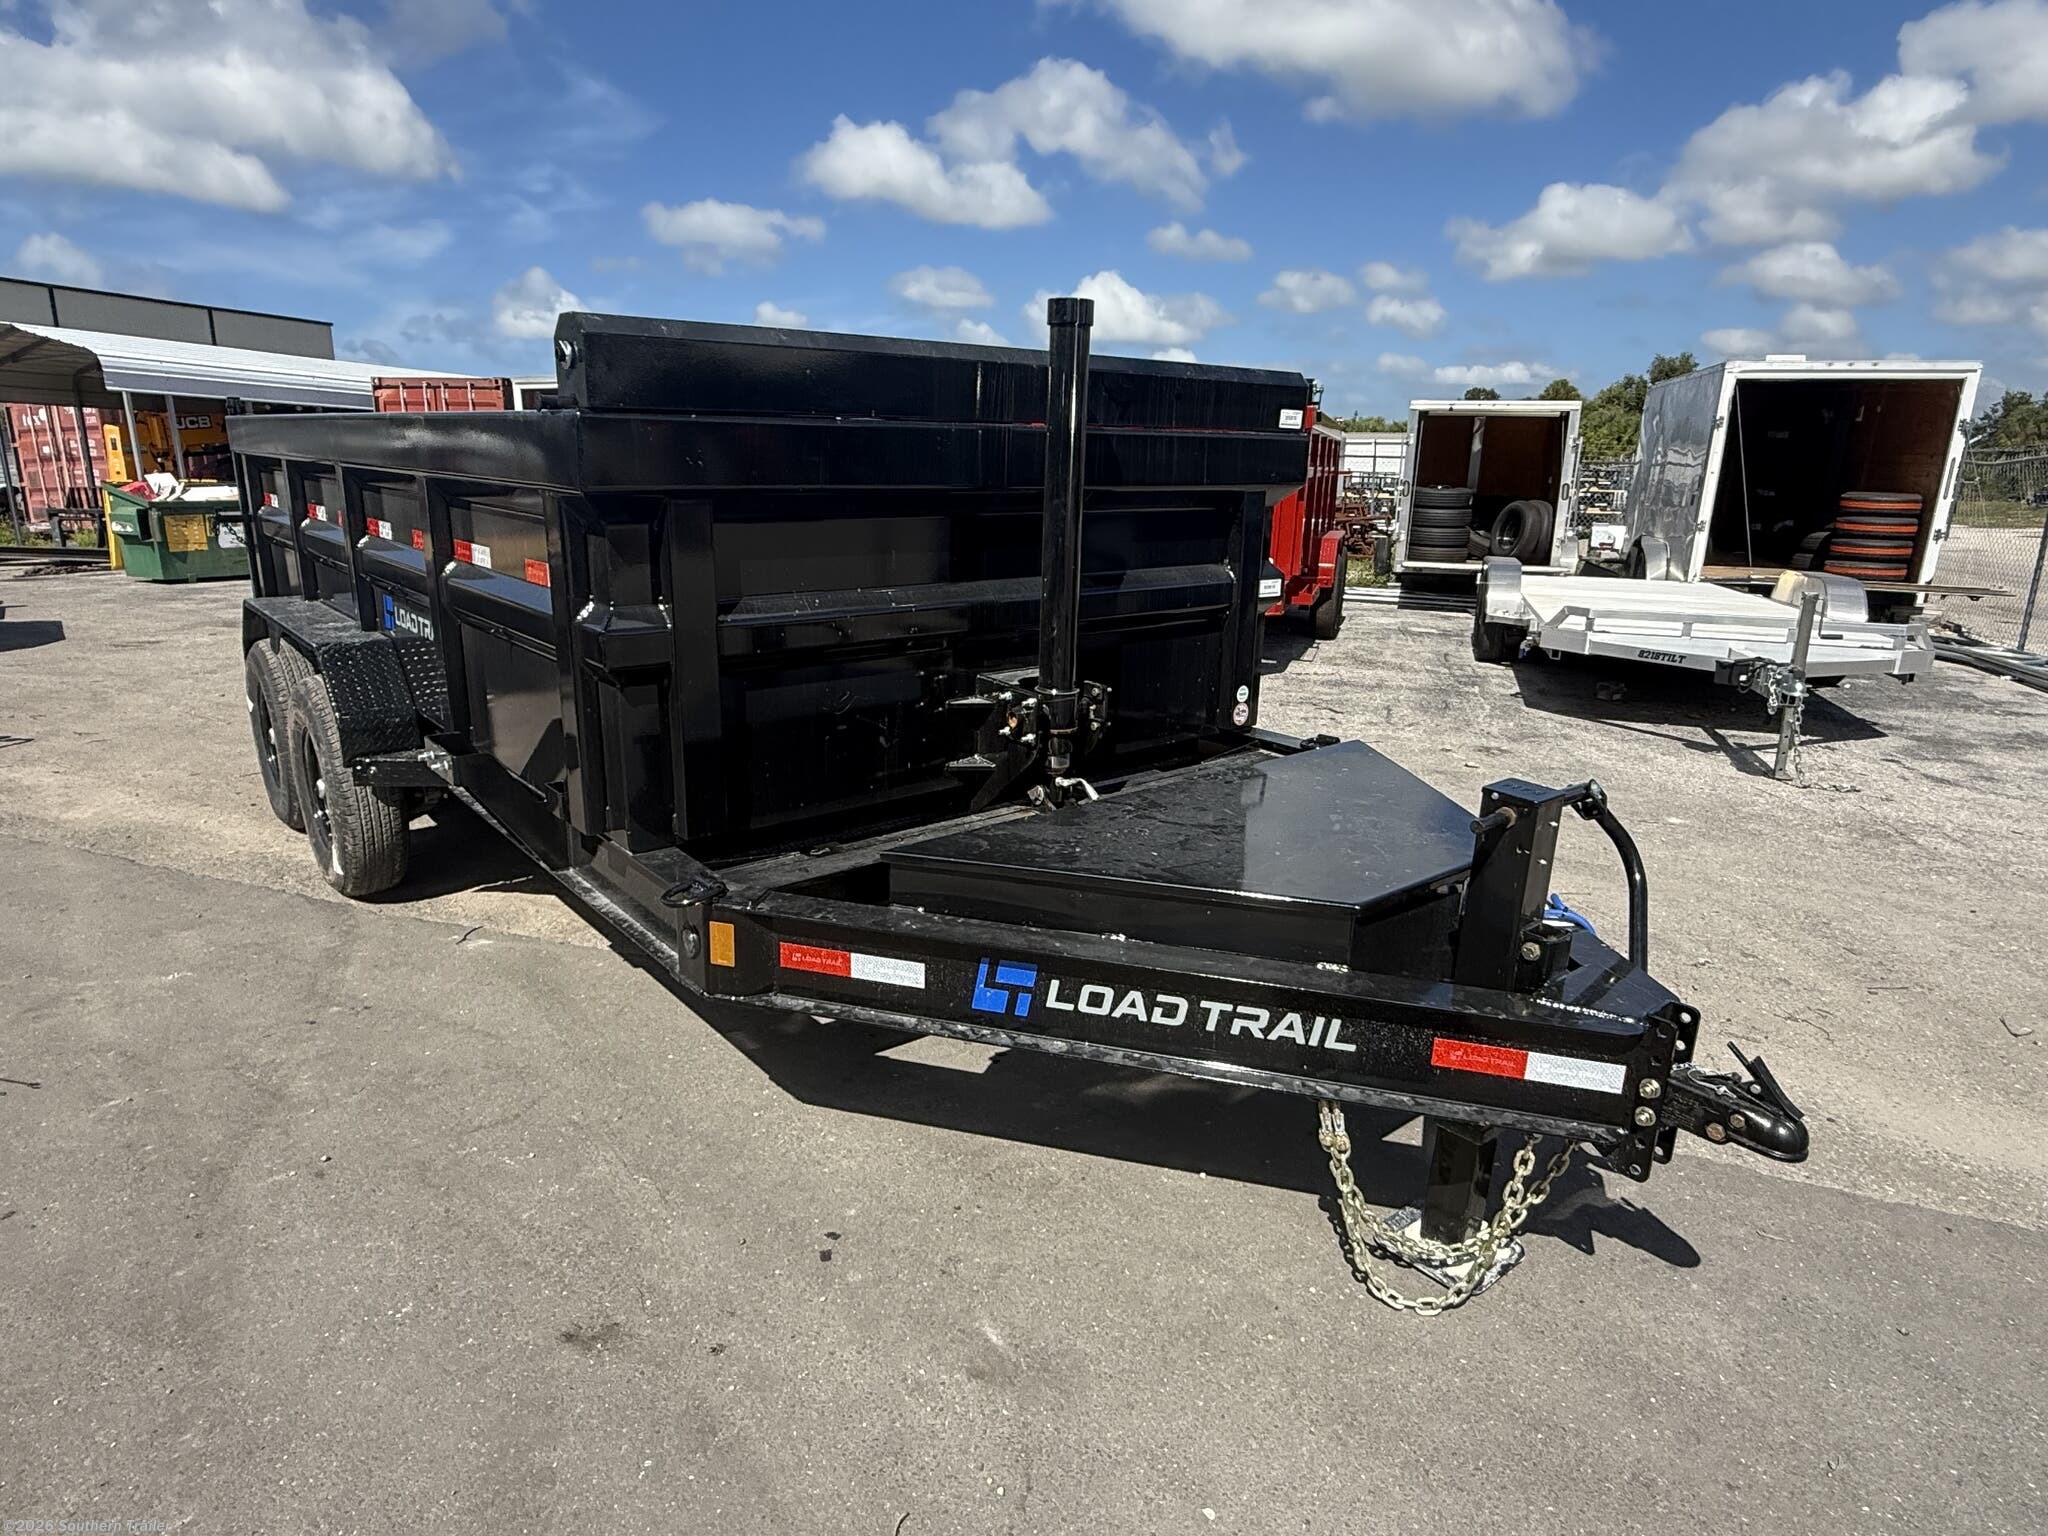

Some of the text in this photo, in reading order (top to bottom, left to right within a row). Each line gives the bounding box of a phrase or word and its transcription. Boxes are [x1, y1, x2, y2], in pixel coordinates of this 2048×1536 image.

[177, 415, 211, 429] JCB
[394, 605, 418, 634] LOAD
[1045, 979, 1358, 1052] LOAD TRAIL
